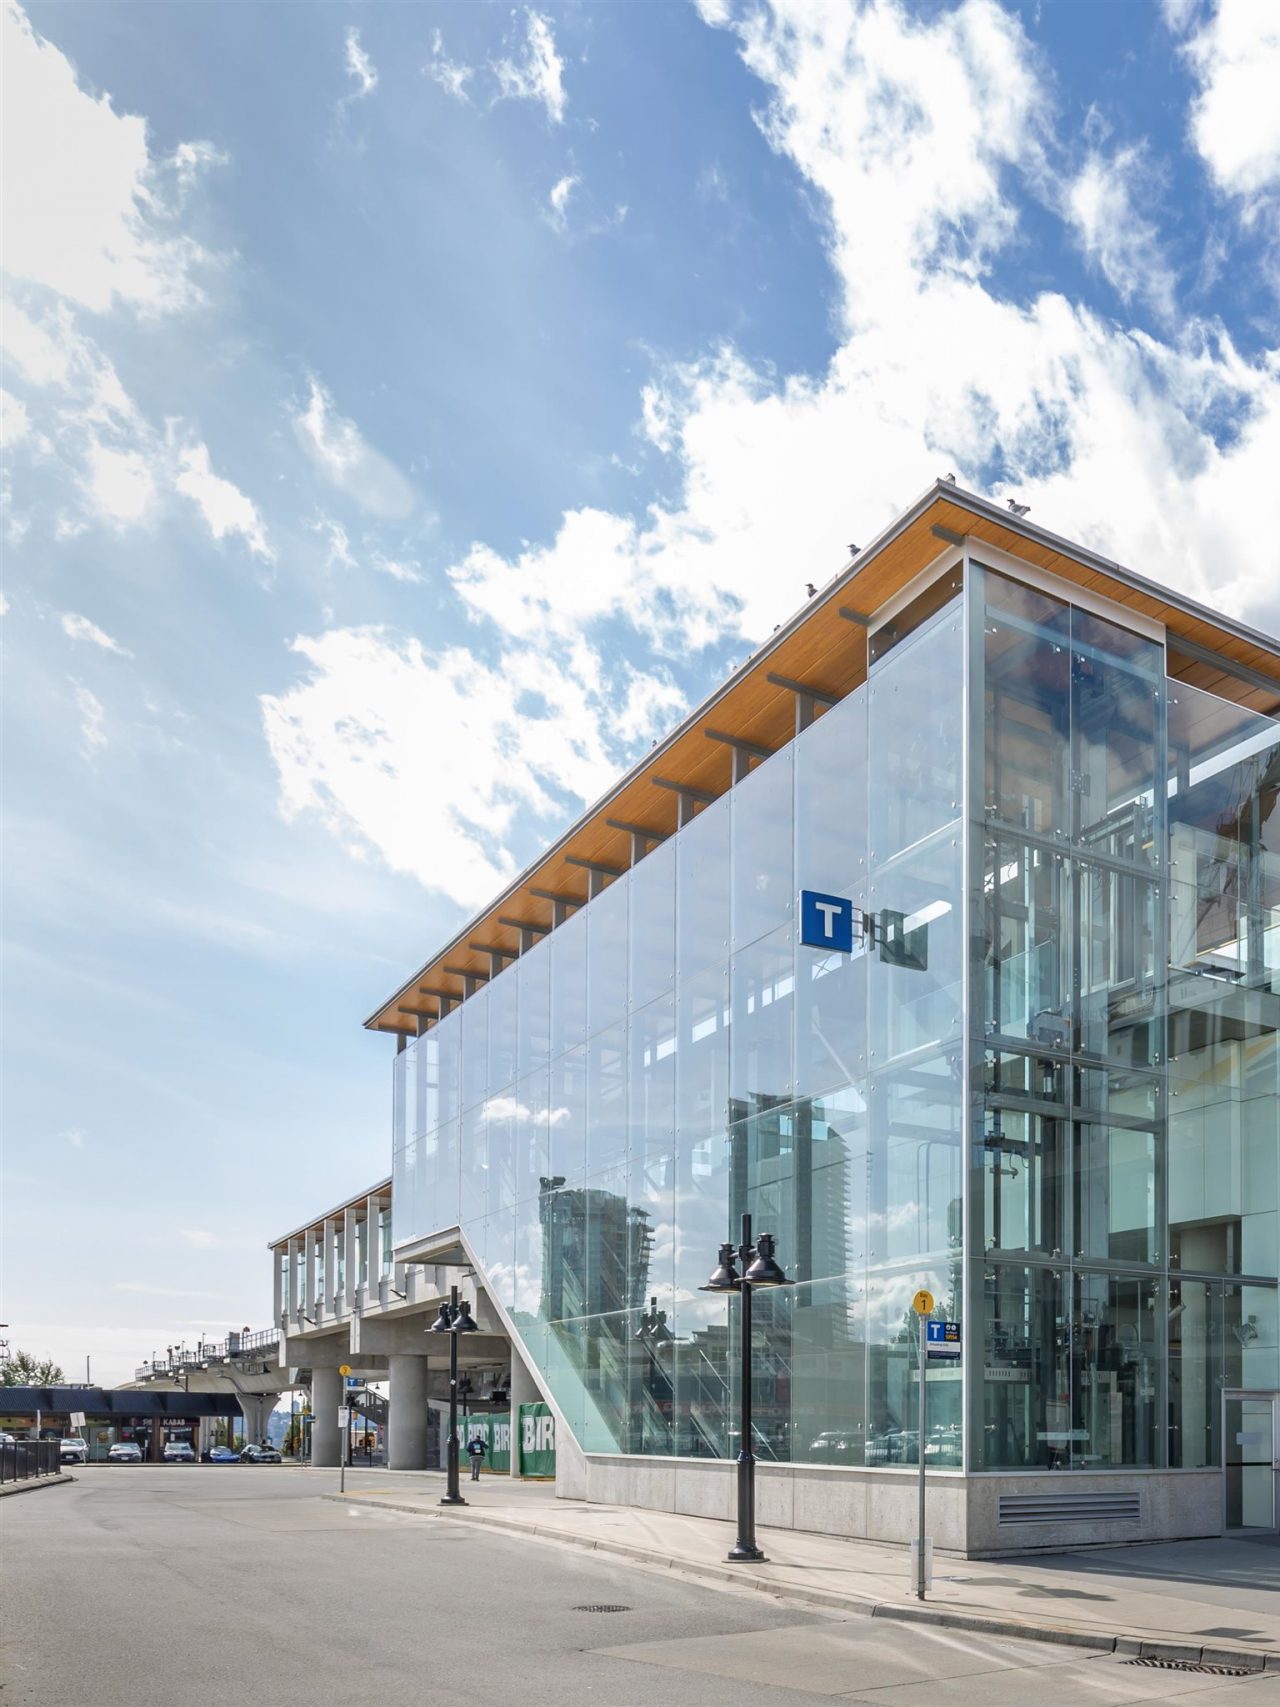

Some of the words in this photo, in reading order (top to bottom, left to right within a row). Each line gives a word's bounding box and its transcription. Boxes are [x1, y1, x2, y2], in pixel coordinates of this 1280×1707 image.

[815, 901, 842, 938] T
[921, 1300, 926, 1310] 1
[930, 1324, 941, 1339] T
[163, 1418, 186, 1426] KABAB
